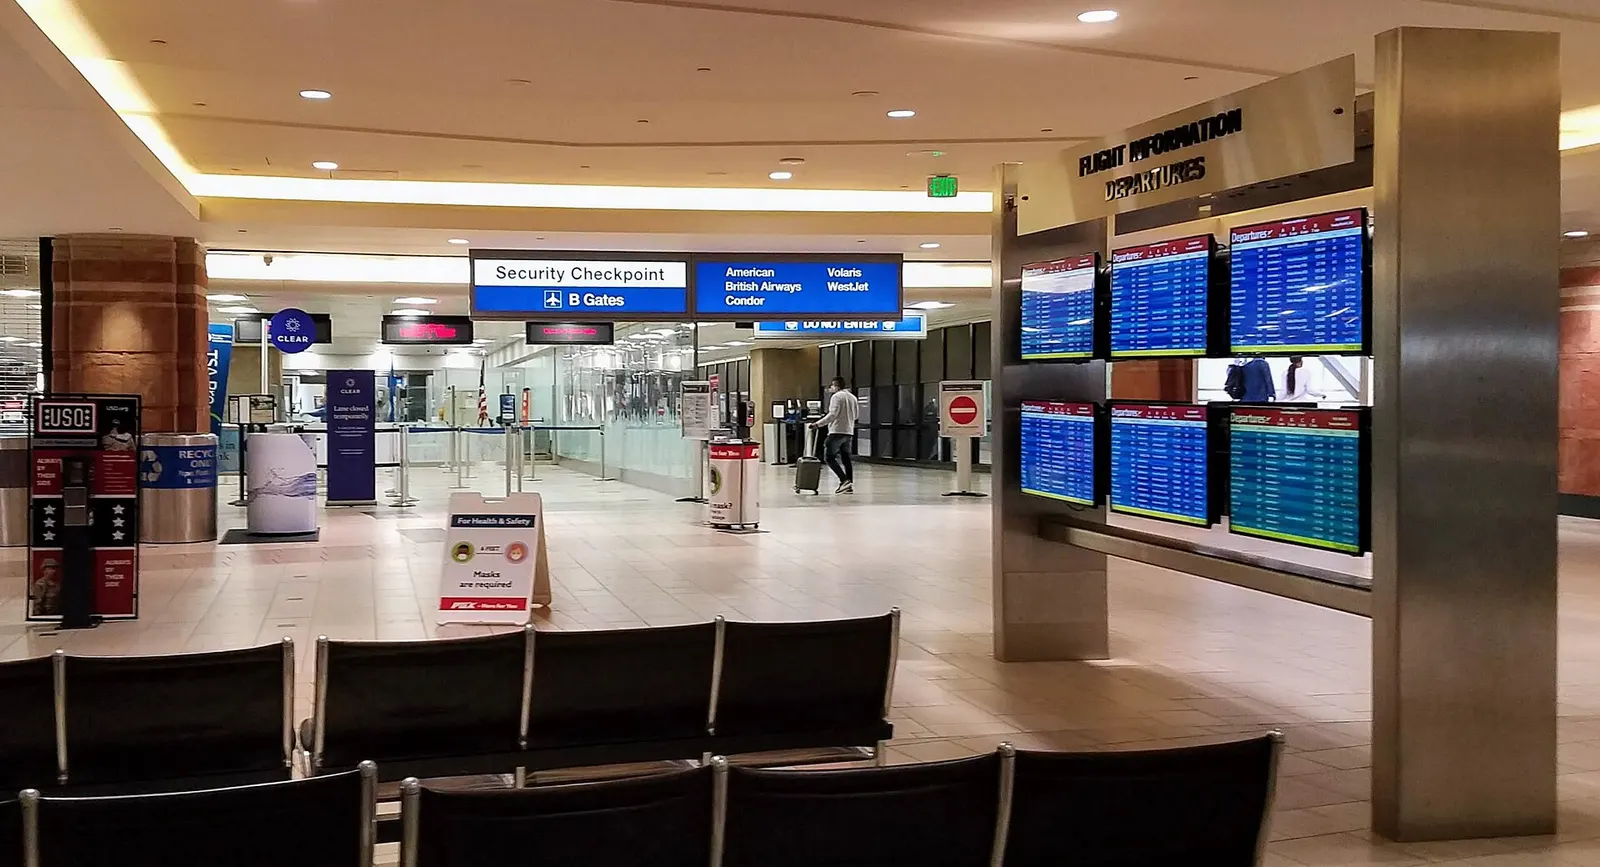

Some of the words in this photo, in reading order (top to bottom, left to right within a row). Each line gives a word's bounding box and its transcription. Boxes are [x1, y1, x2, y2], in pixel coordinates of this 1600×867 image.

[1078, 144, 1126, 177] FLIGHT
[1129, 108, 1242, 163] INFORMATION
[1104, 156, 1206, 202] DEPARTURES
[496, 265, 565, 283] Security
[570, 266, 665, 284] Checkpoint
[725, 267, 775, 278] American
[827, 267, 862, 278] Volaris
[725, 281, 759, 292] British
[760, 281, 802, 294] Airways
[827, 281, 869, 292] WestJet
[568, 292, 580, 306] B
[583, 293, 625, 307] Gates
[725, 295, 765, 306] Condor
[277, 335, 309, 343] CLEAR
[207, 349, 218, 376] TSA
[50, 408, 84, 427] USO
[457, 517, 471, 525] For
[471, 517, 498, 525] Health
[505, 517, 531, 526] Safety
[473, 570, 501, 578] Masks
[475, 581, 512, 589] required
